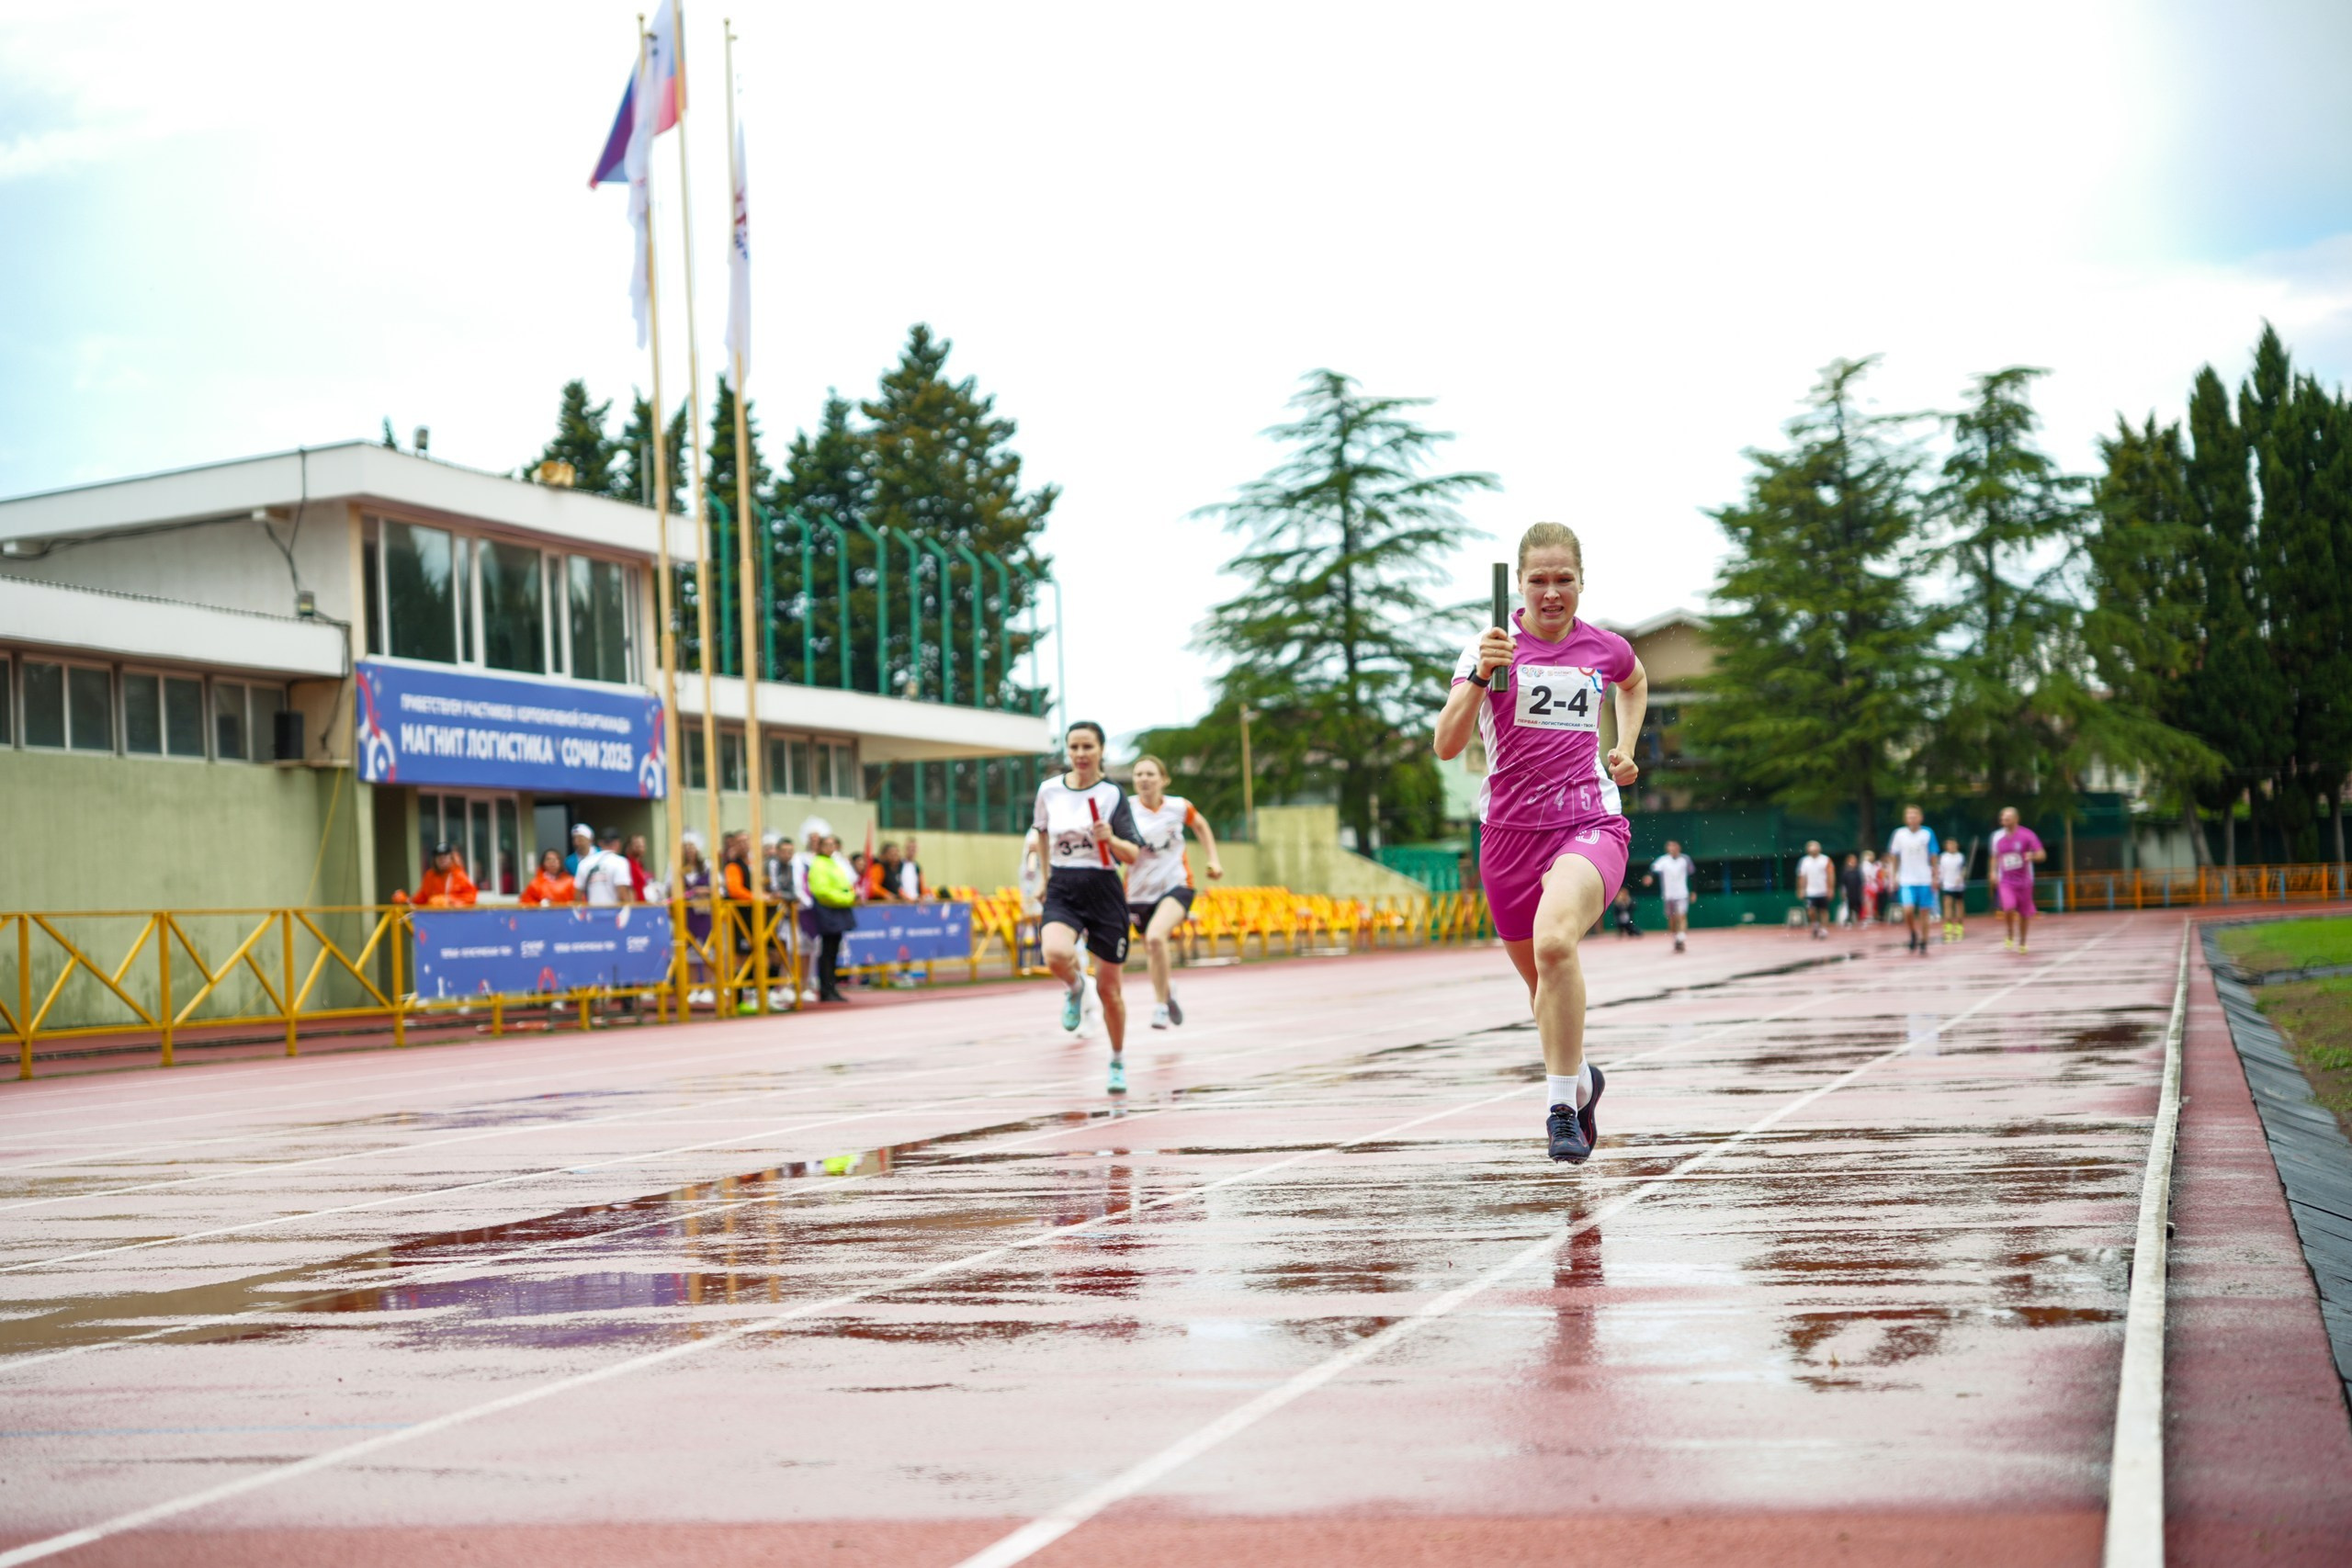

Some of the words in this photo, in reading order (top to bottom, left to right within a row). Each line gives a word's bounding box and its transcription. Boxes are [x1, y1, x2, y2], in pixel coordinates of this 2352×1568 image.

[1529, 684, 1589, 716] 2-4
[401, 722, 465, 758] МАГНИТ
[467, 728, 555, 765] ЛОГИСТИКА
[561, 736, 600, 769] СОЧИ
[601, 739, 634, 773] 2025
[1579, 784, 1591, 811] 5
[1059, 834, 1093, 856] 3-4
